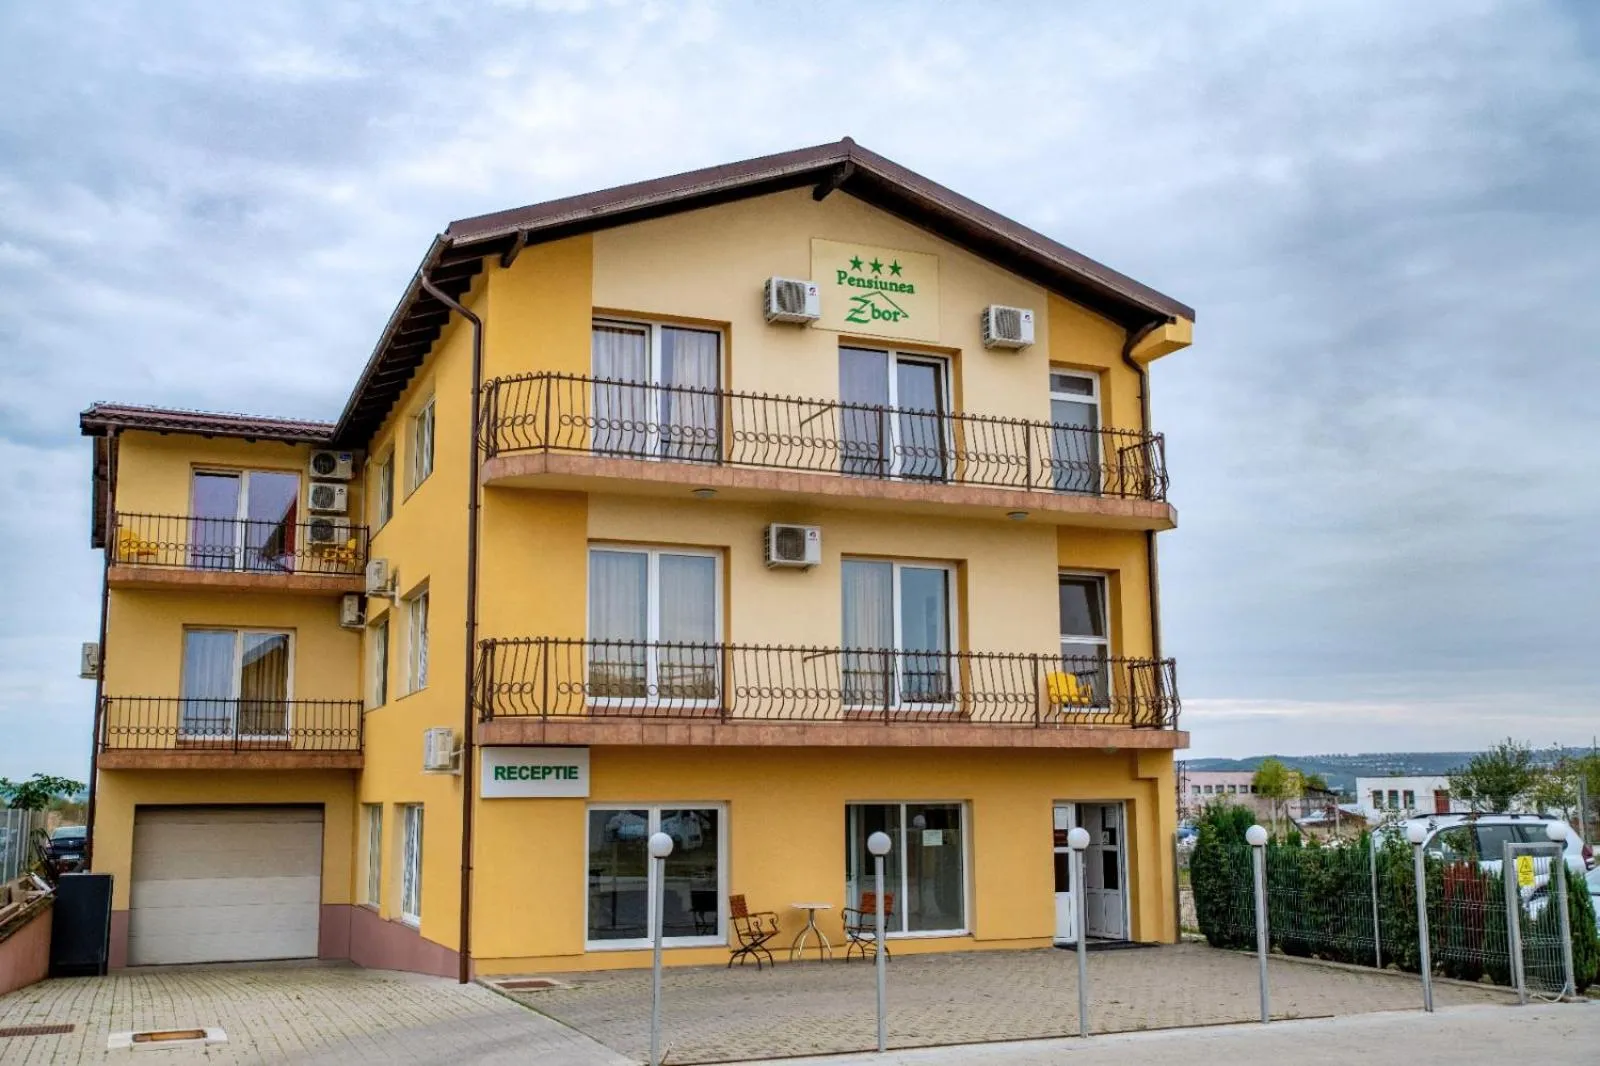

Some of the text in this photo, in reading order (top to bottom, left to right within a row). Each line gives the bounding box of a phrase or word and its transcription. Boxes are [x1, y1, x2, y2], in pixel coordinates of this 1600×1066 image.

[836, 270, 915, 294] Pensiunea
[844, 296, 901, 324] Zbor
[494, 765, 579, 780] RECEPTIE
